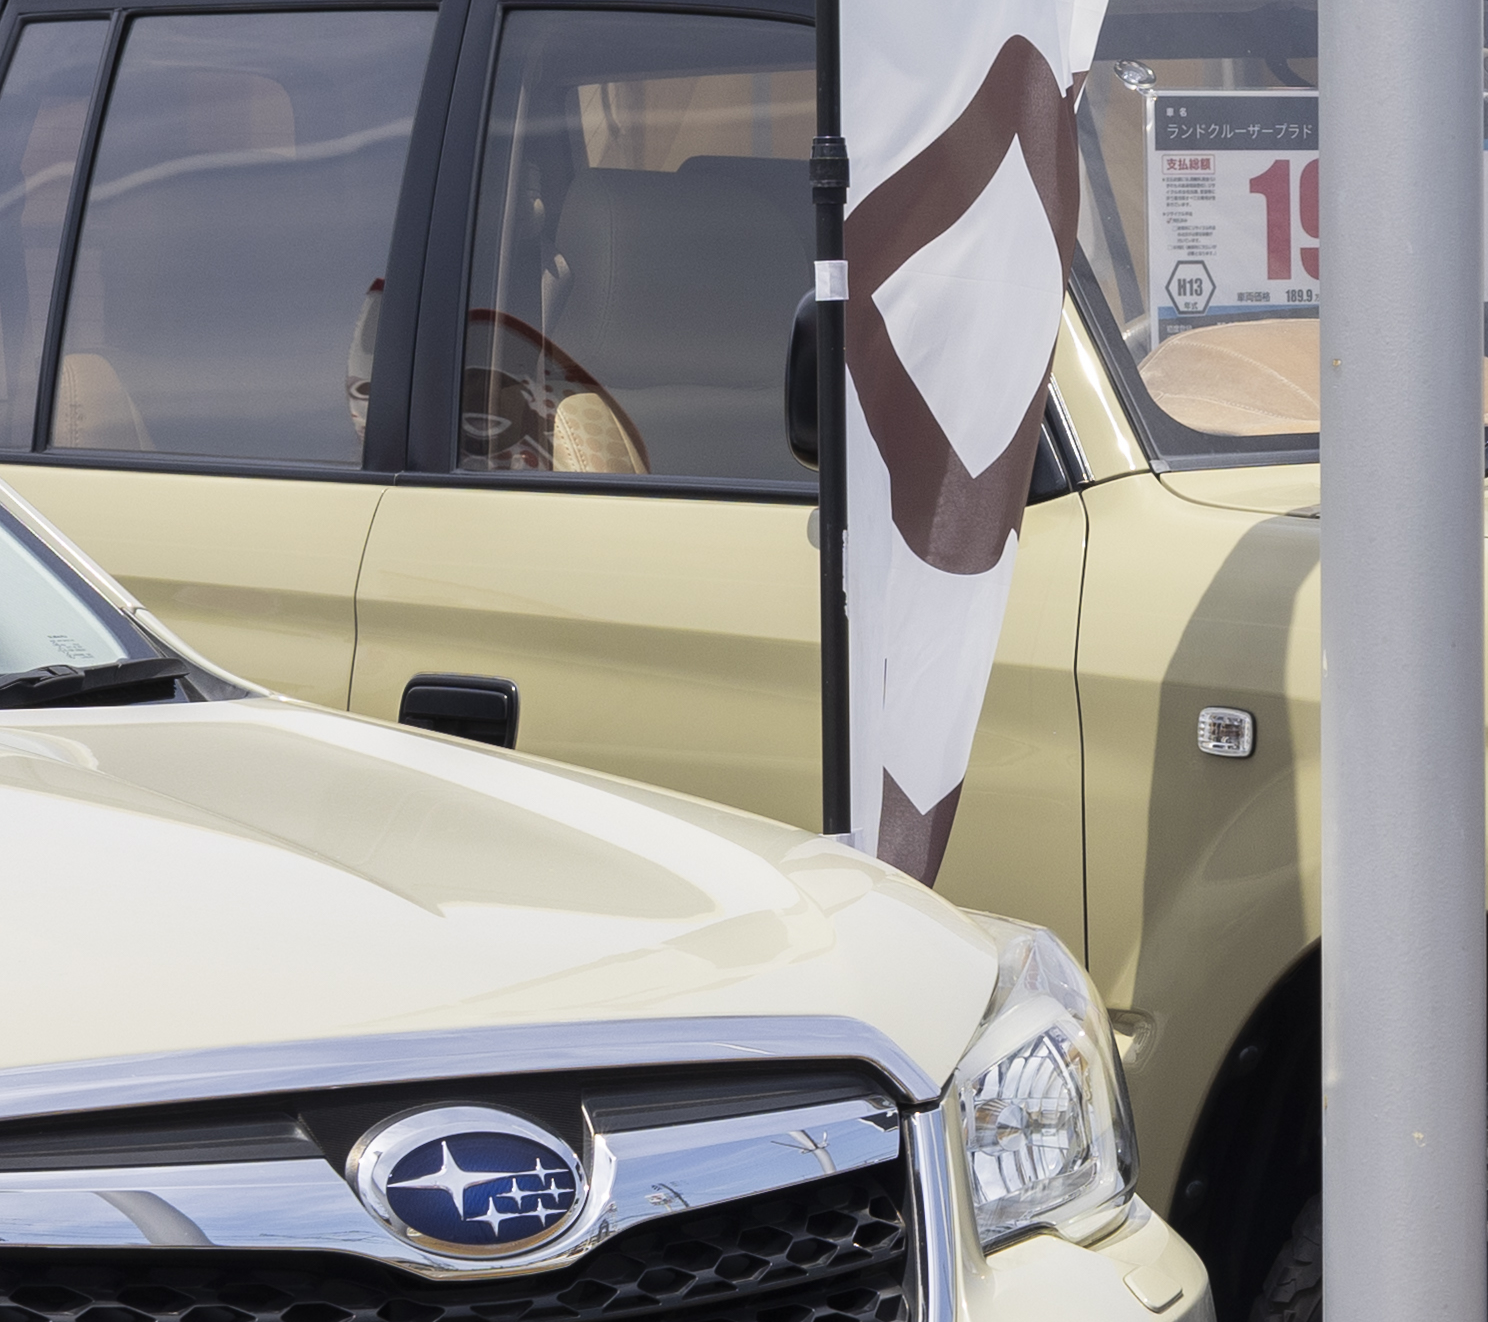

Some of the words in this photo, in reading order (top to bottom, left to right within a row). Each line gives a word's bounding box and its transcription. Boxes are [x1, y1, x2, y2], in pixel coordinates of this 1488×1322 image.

[1166, 122, 1313, 139] ランドクルーザープラド
[1166, 158, 1211, 171] 支払総額
[1177, 277, 1203, 297] H13
[1285, 288, 1313, 303] 189.9
